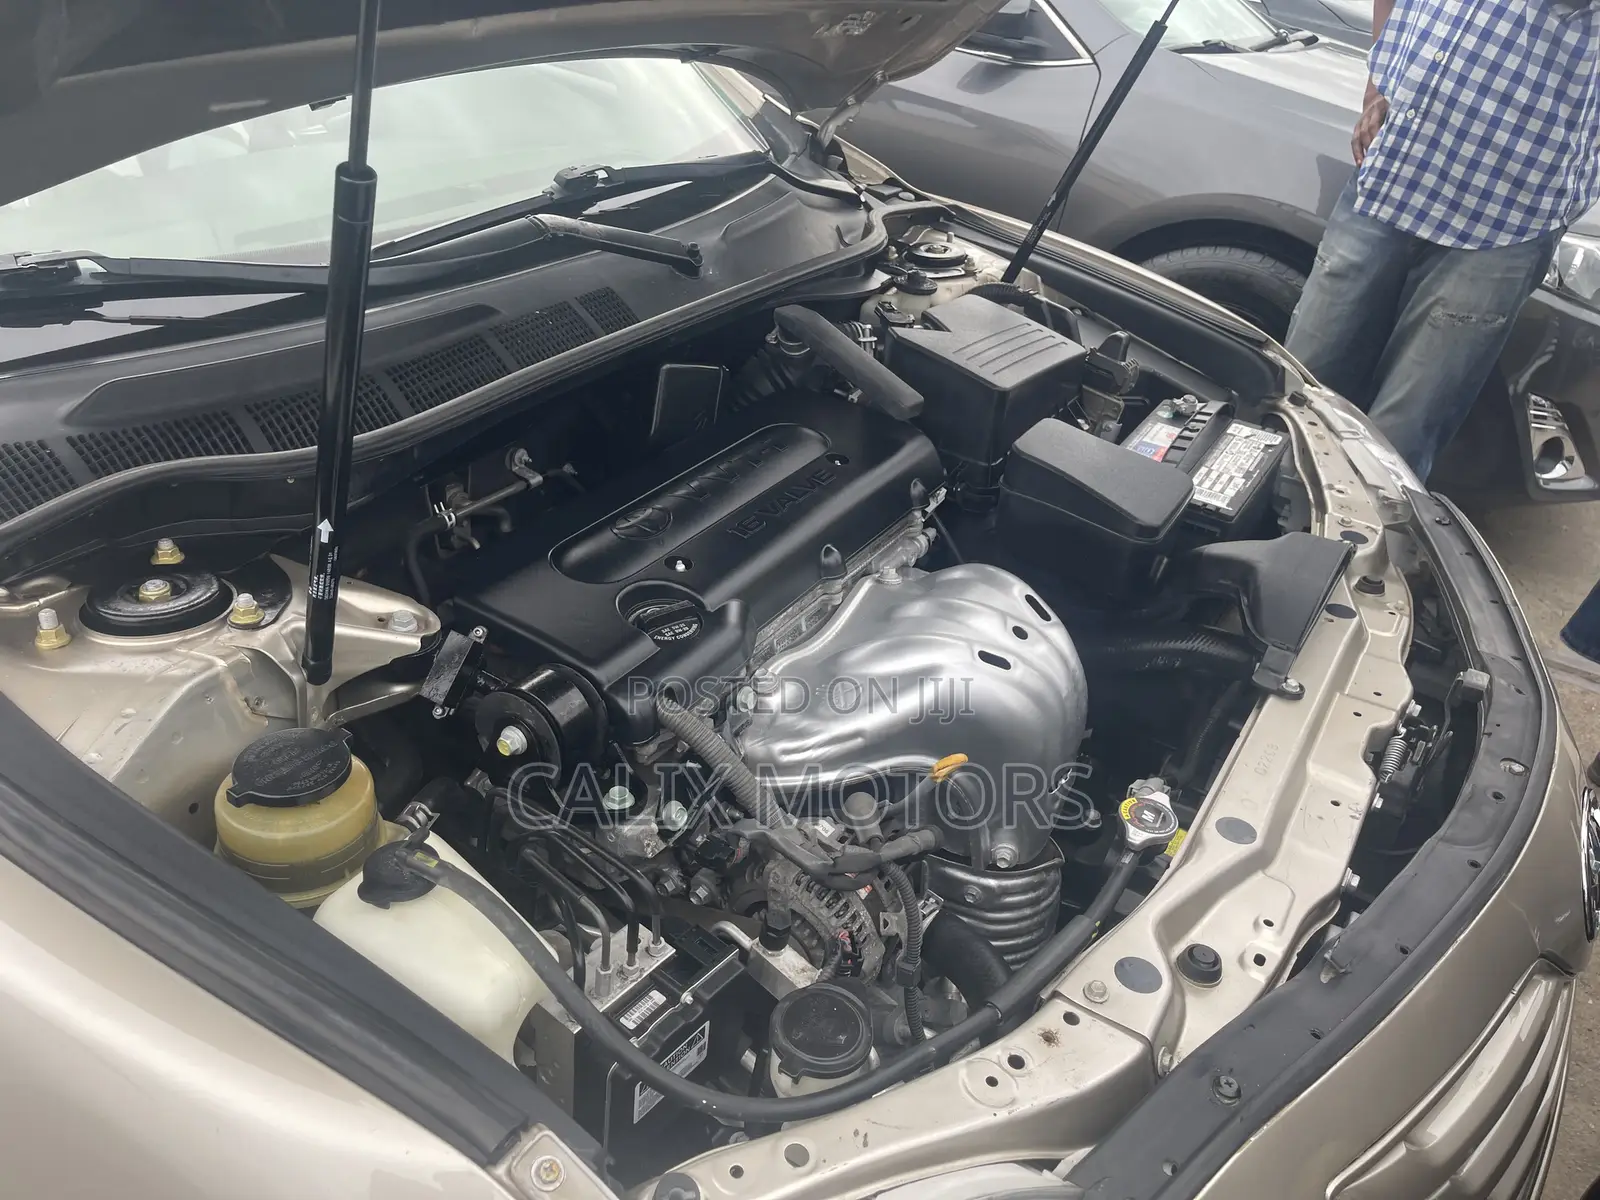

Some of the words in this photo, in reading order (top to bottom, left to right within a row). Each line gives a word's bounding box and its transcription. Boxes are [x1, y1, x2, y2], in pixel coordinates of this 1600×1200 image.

[754, 469, 836, 518] VALVE
[661, 1043, 689, 1068] AUTION
[666, 1046, 692, 1070] ENTION
